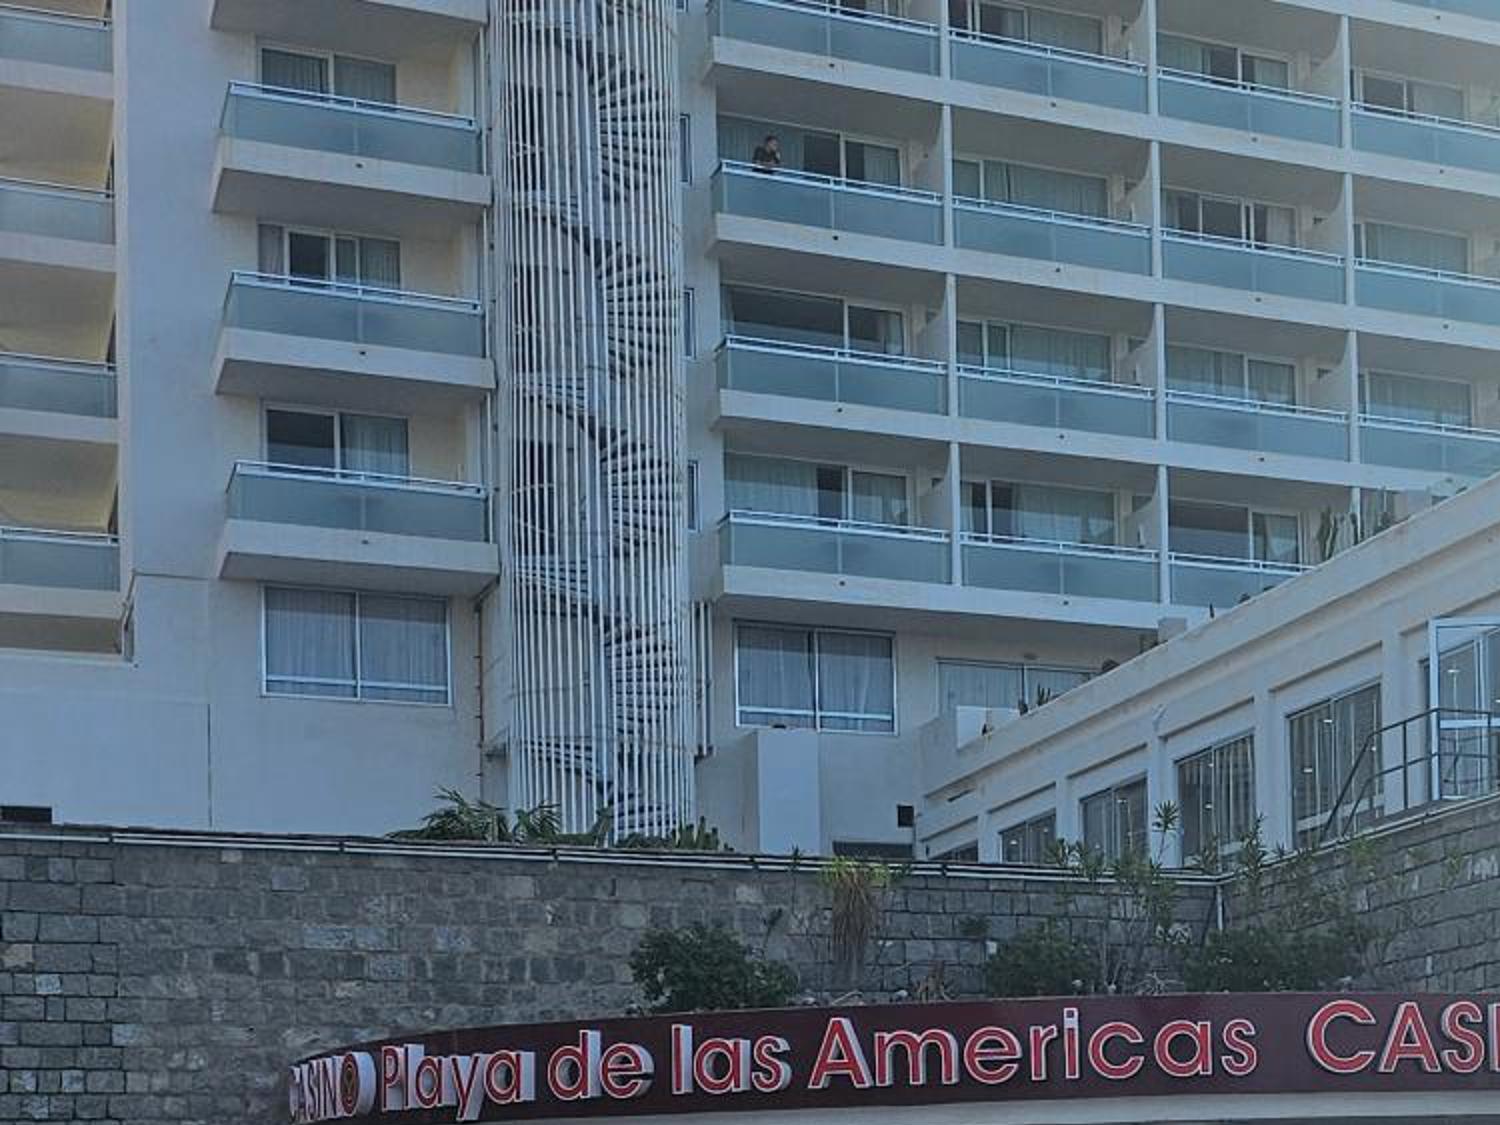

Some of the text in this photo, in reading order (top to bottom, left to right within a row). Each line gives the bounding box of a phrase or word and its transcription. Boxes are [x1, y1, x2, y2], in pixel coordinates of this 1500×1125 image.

[380, 1044, 535, 1121] Playa
[547, 1030, 653, 1100] de
[672, 1024, 790, 1095] las
[808, 1008, 1258, 1089] Americas
